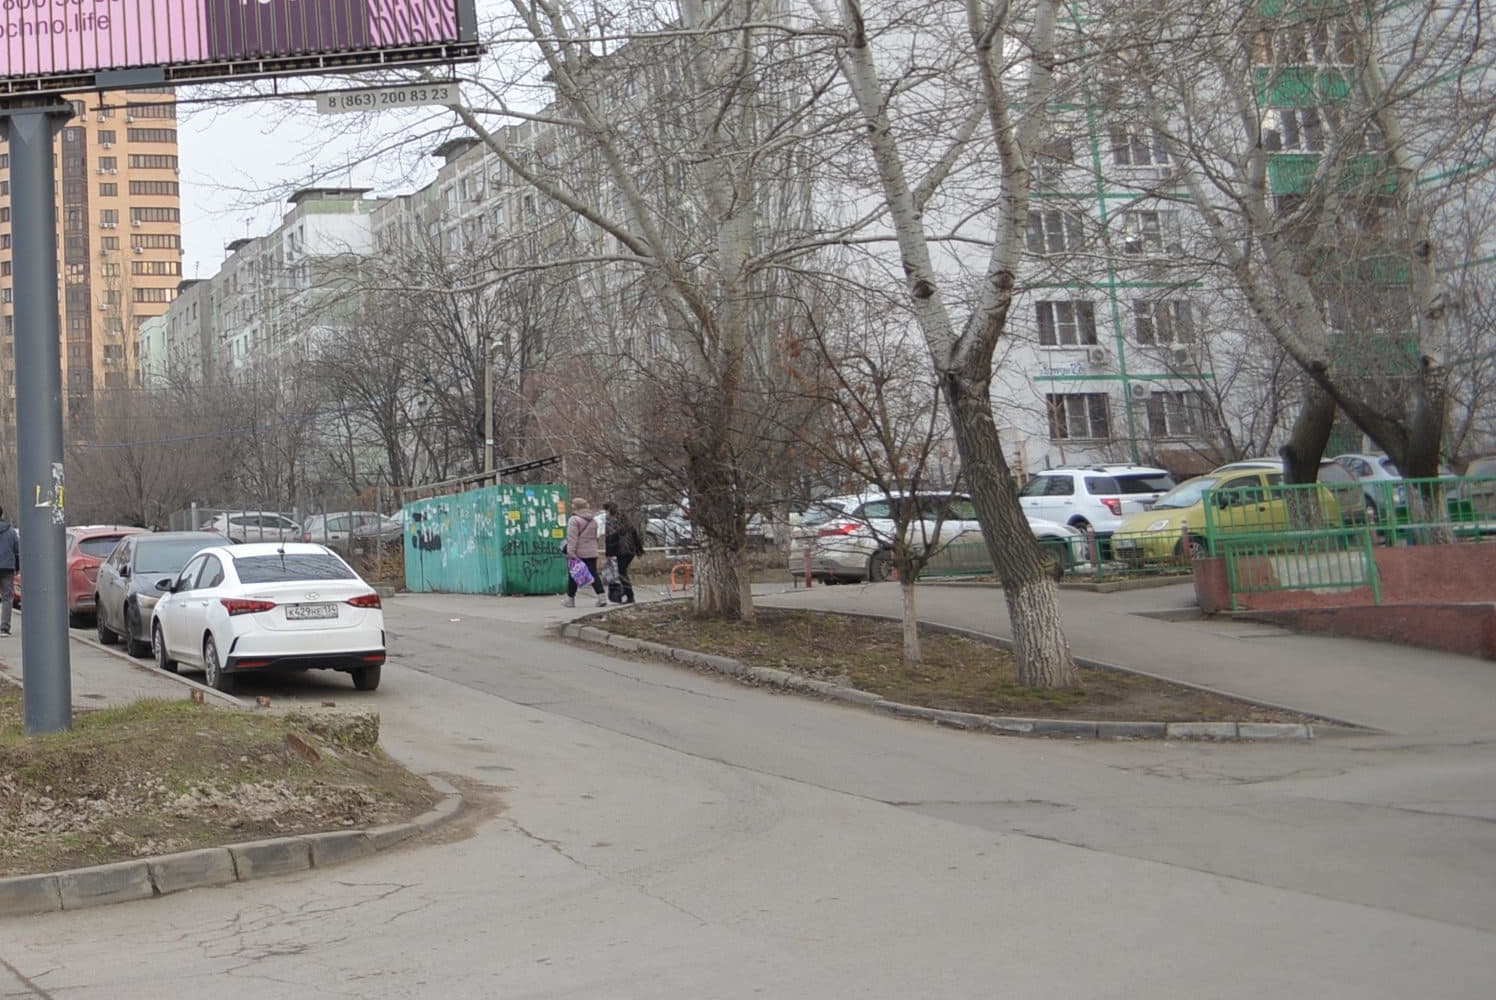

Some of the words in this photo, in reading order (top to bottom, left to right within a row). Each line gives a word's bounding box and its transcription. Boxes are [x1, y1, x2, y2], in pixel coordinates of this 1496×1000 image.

[328, 98, 337, 108] 8
[340, 95, 377, 110] (863)
[381, 92, 406, 104] 200
[410, 90, 428, 102] 83
[431, 89, 449, 100] 23
